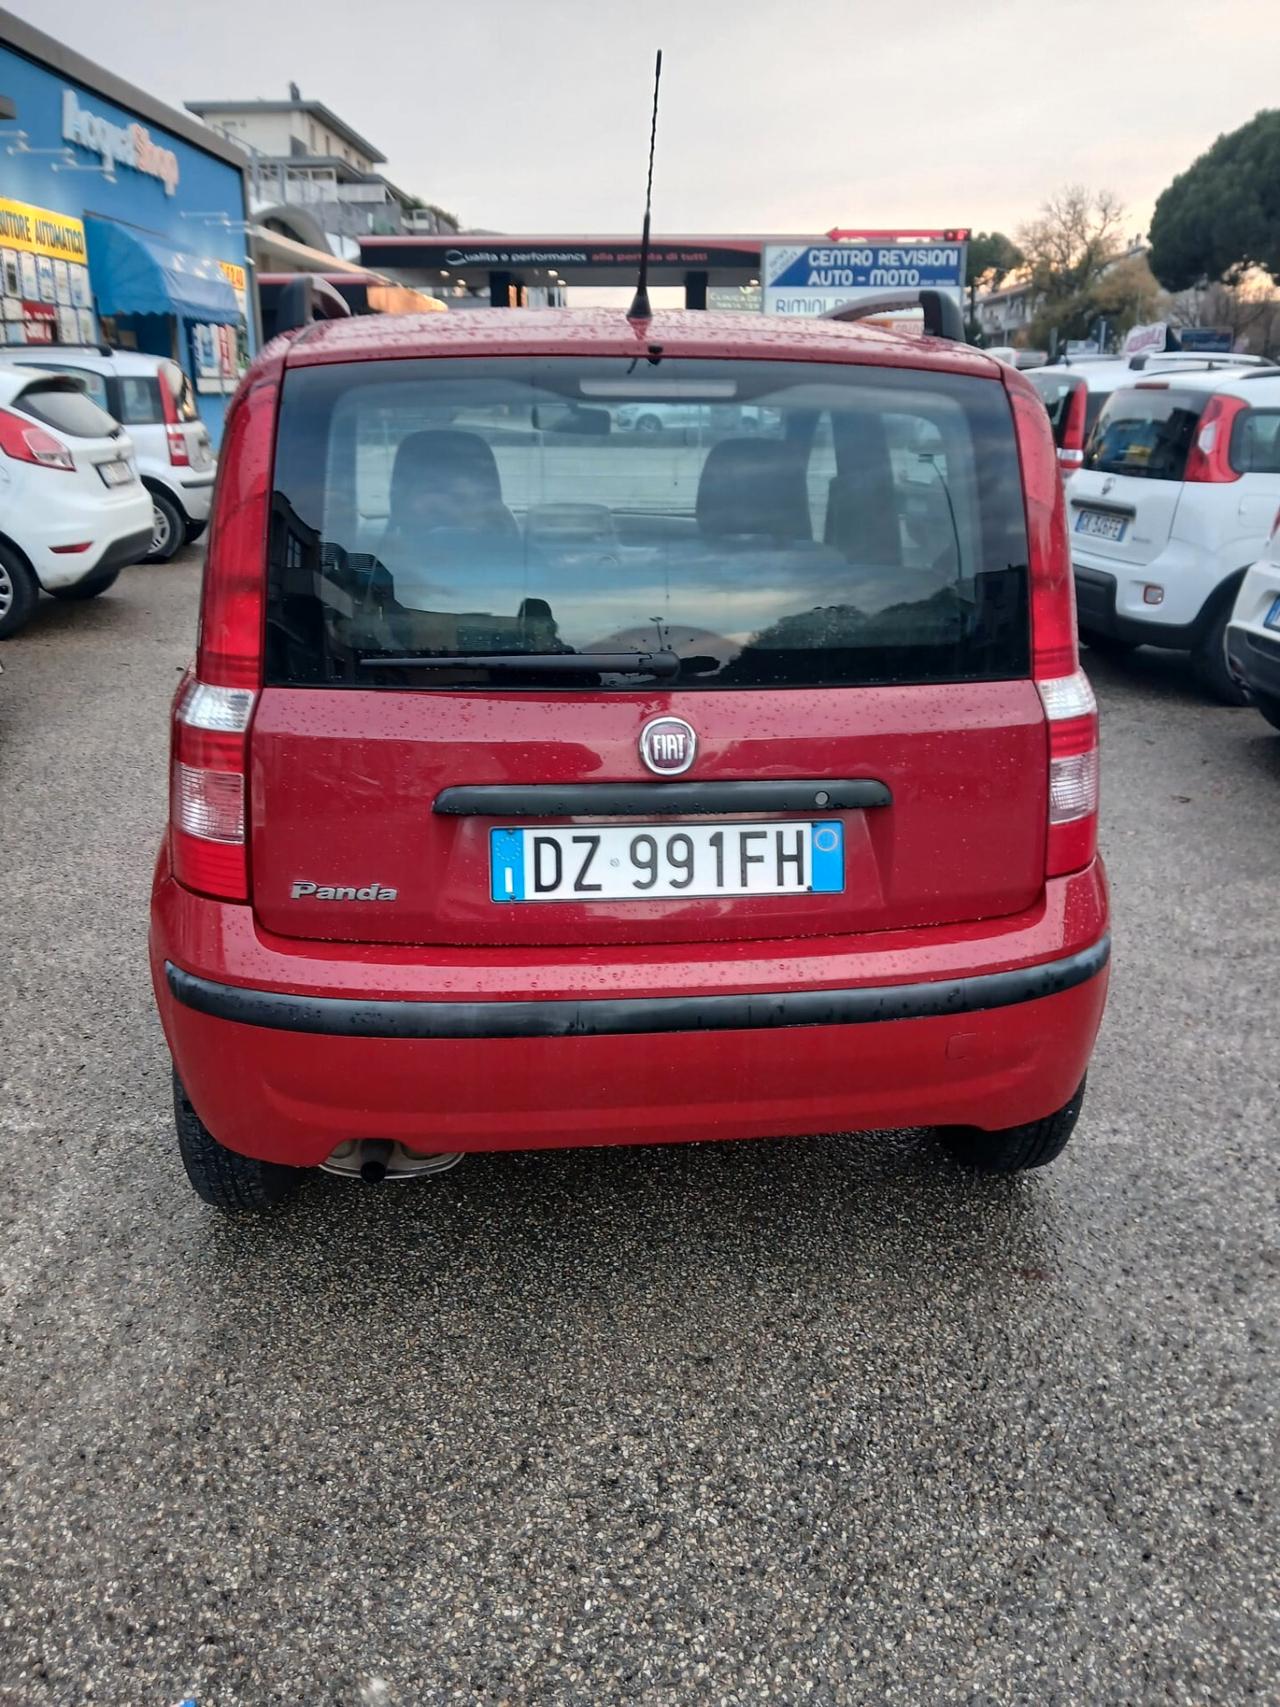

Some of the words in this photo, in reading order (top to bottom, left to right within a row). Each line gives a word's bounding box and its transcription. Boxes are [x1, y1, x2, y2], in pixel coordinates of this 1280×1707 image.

[35, 218, 84, 255] AUTOMATICO
[809, 249, 873, 267] CENTRO
[878, 249, 958, 267] REVISIONI
[808, 269, 853, 286] AUTO
[869, 269, 919, 286] MOTO
[776, 298, 826, 313] RIMINI
[652, 734, 686, 760] FIAT
[533, 835, 602, 893] DZ
[629, 830, 804, 890] 991FH
[290, 881, 398, 901] Panda
